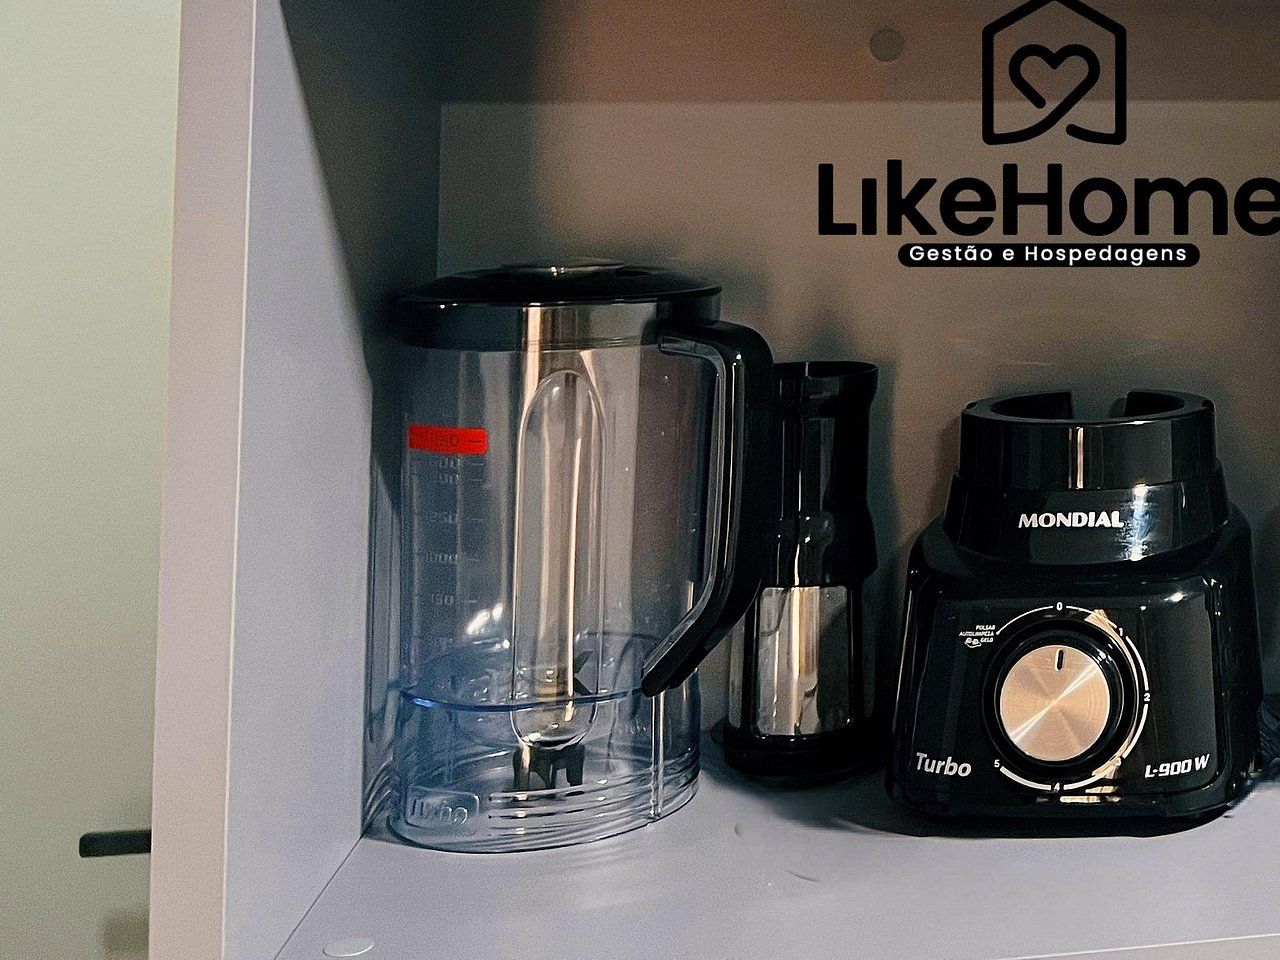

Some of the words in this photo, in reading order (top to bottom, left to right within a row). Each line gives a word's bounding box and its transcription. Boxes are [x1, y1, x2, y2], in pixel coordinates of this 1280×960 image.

[1018, 510, 1125, 529] MONDIAL
[1056, 601, 1063, 611] 0
[1118, 627, 1124, 637] 1
[1143, 693, 1151, 702] 2
[916, 752, 972, 778] Turbo
[993, 759, 1001, 768] 5
[1191, 753, 1211, 771] W
[1053, 782, 1061, 793] 4
